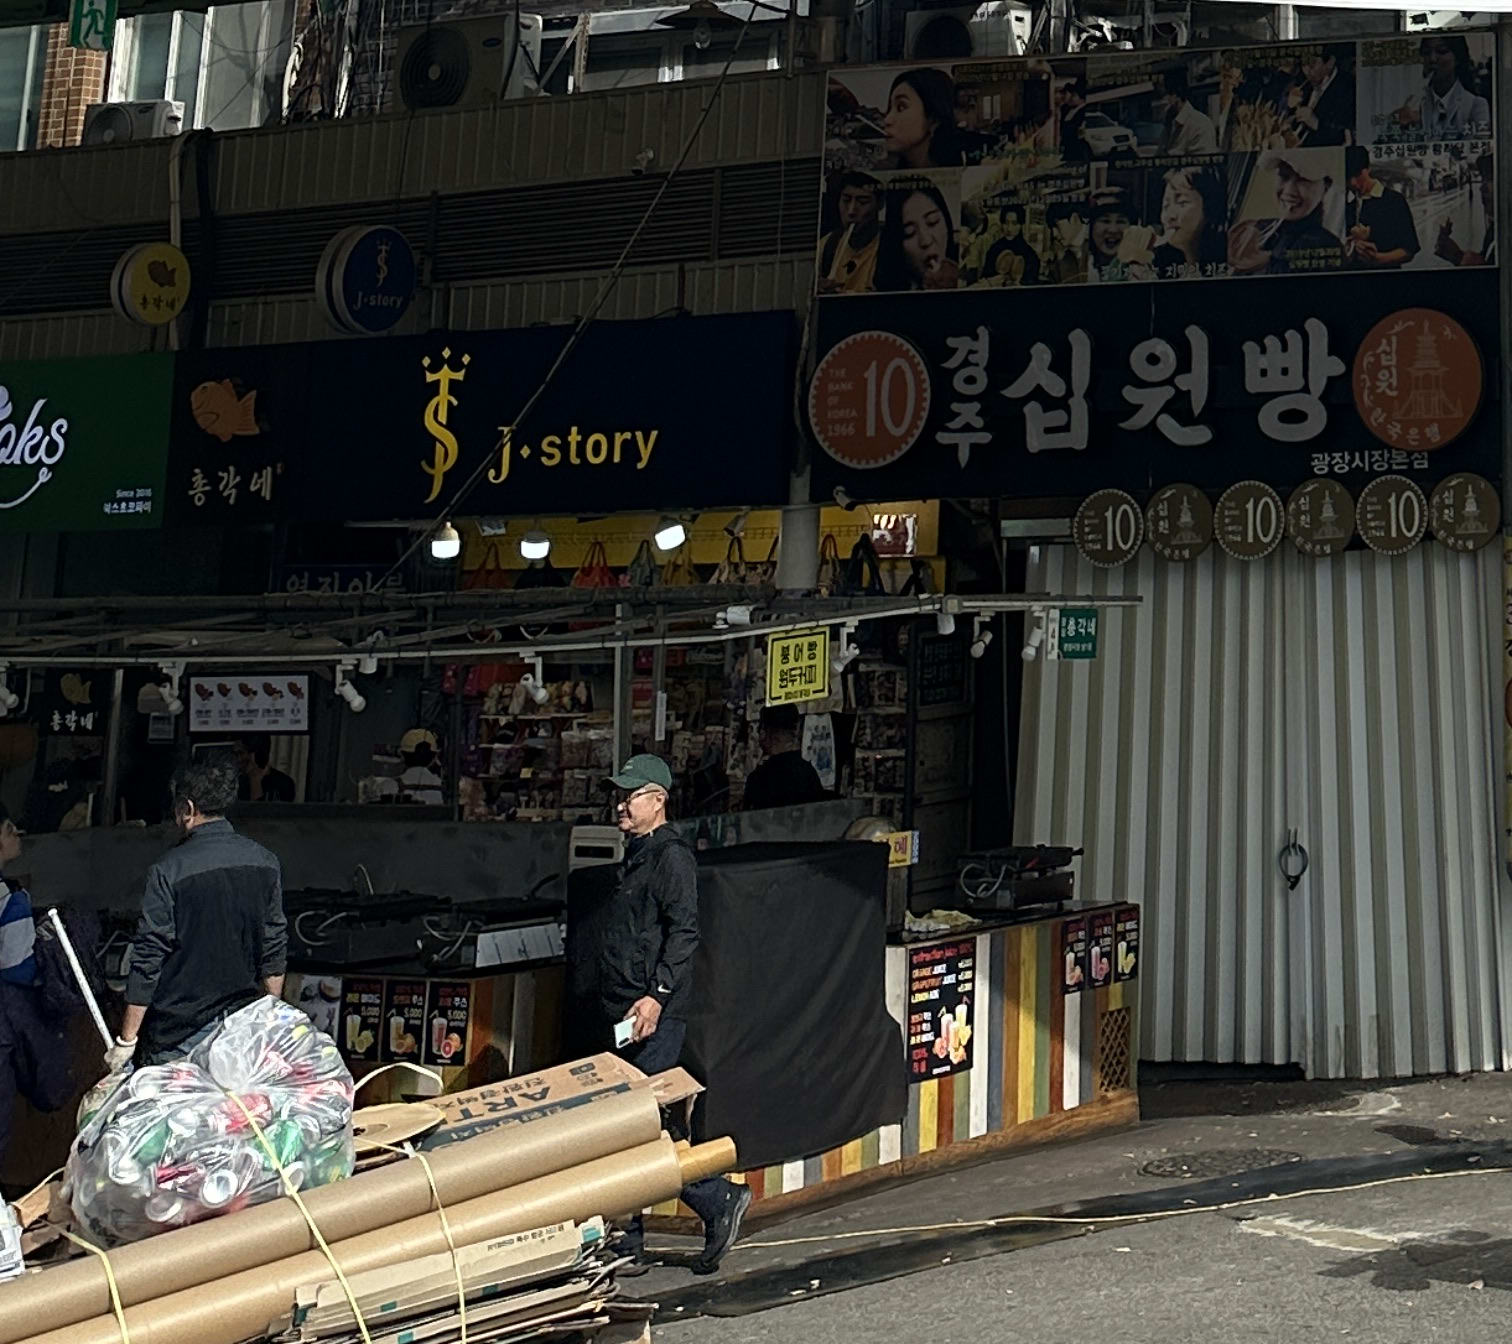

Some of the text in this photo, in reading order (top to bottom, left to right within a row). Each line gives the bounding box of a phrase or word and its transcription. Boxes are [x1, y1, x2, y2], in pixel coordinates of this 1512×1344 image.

[1002, 317, 1346, 453] 십원빵
[1376, 334, 1399, 397] 십원
[864, 357, 916, 438] 10
[935, 325, 992, 469] 경주
[187, 463, 275, 507] 총각네
[1104, 504, 1135, 552] 10
[1246, 496, 1277, 544] 10
[1388, 490, 1419, 538] 10
